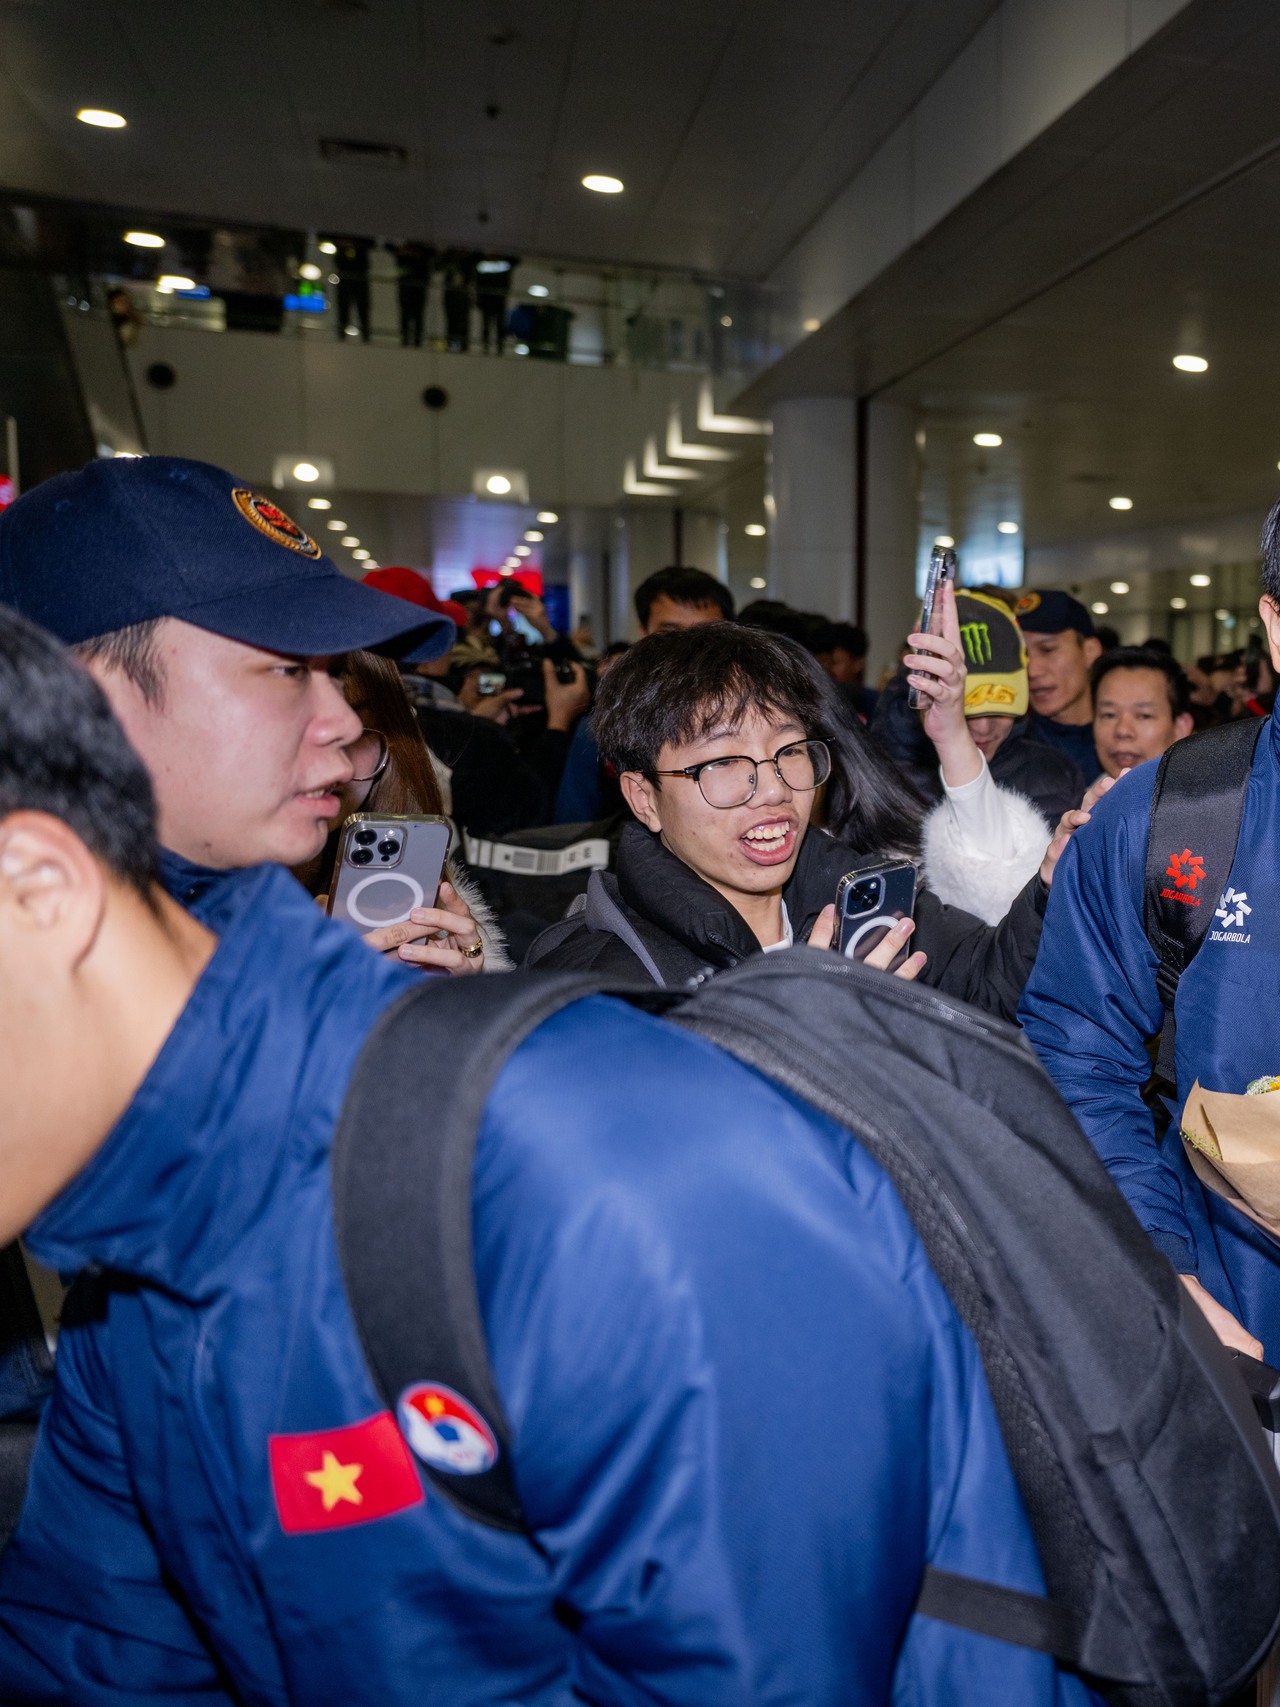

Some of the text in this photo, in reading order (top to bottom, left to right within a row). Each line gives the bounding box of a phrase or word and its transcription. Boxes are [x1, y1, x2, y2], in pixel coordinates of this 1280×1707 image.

[964, 684, 1017, 708] 46
[1160, 888, 1201, 907] JOGARBOLA
[1208, 930, 1252, 944] JOGARBOLA
